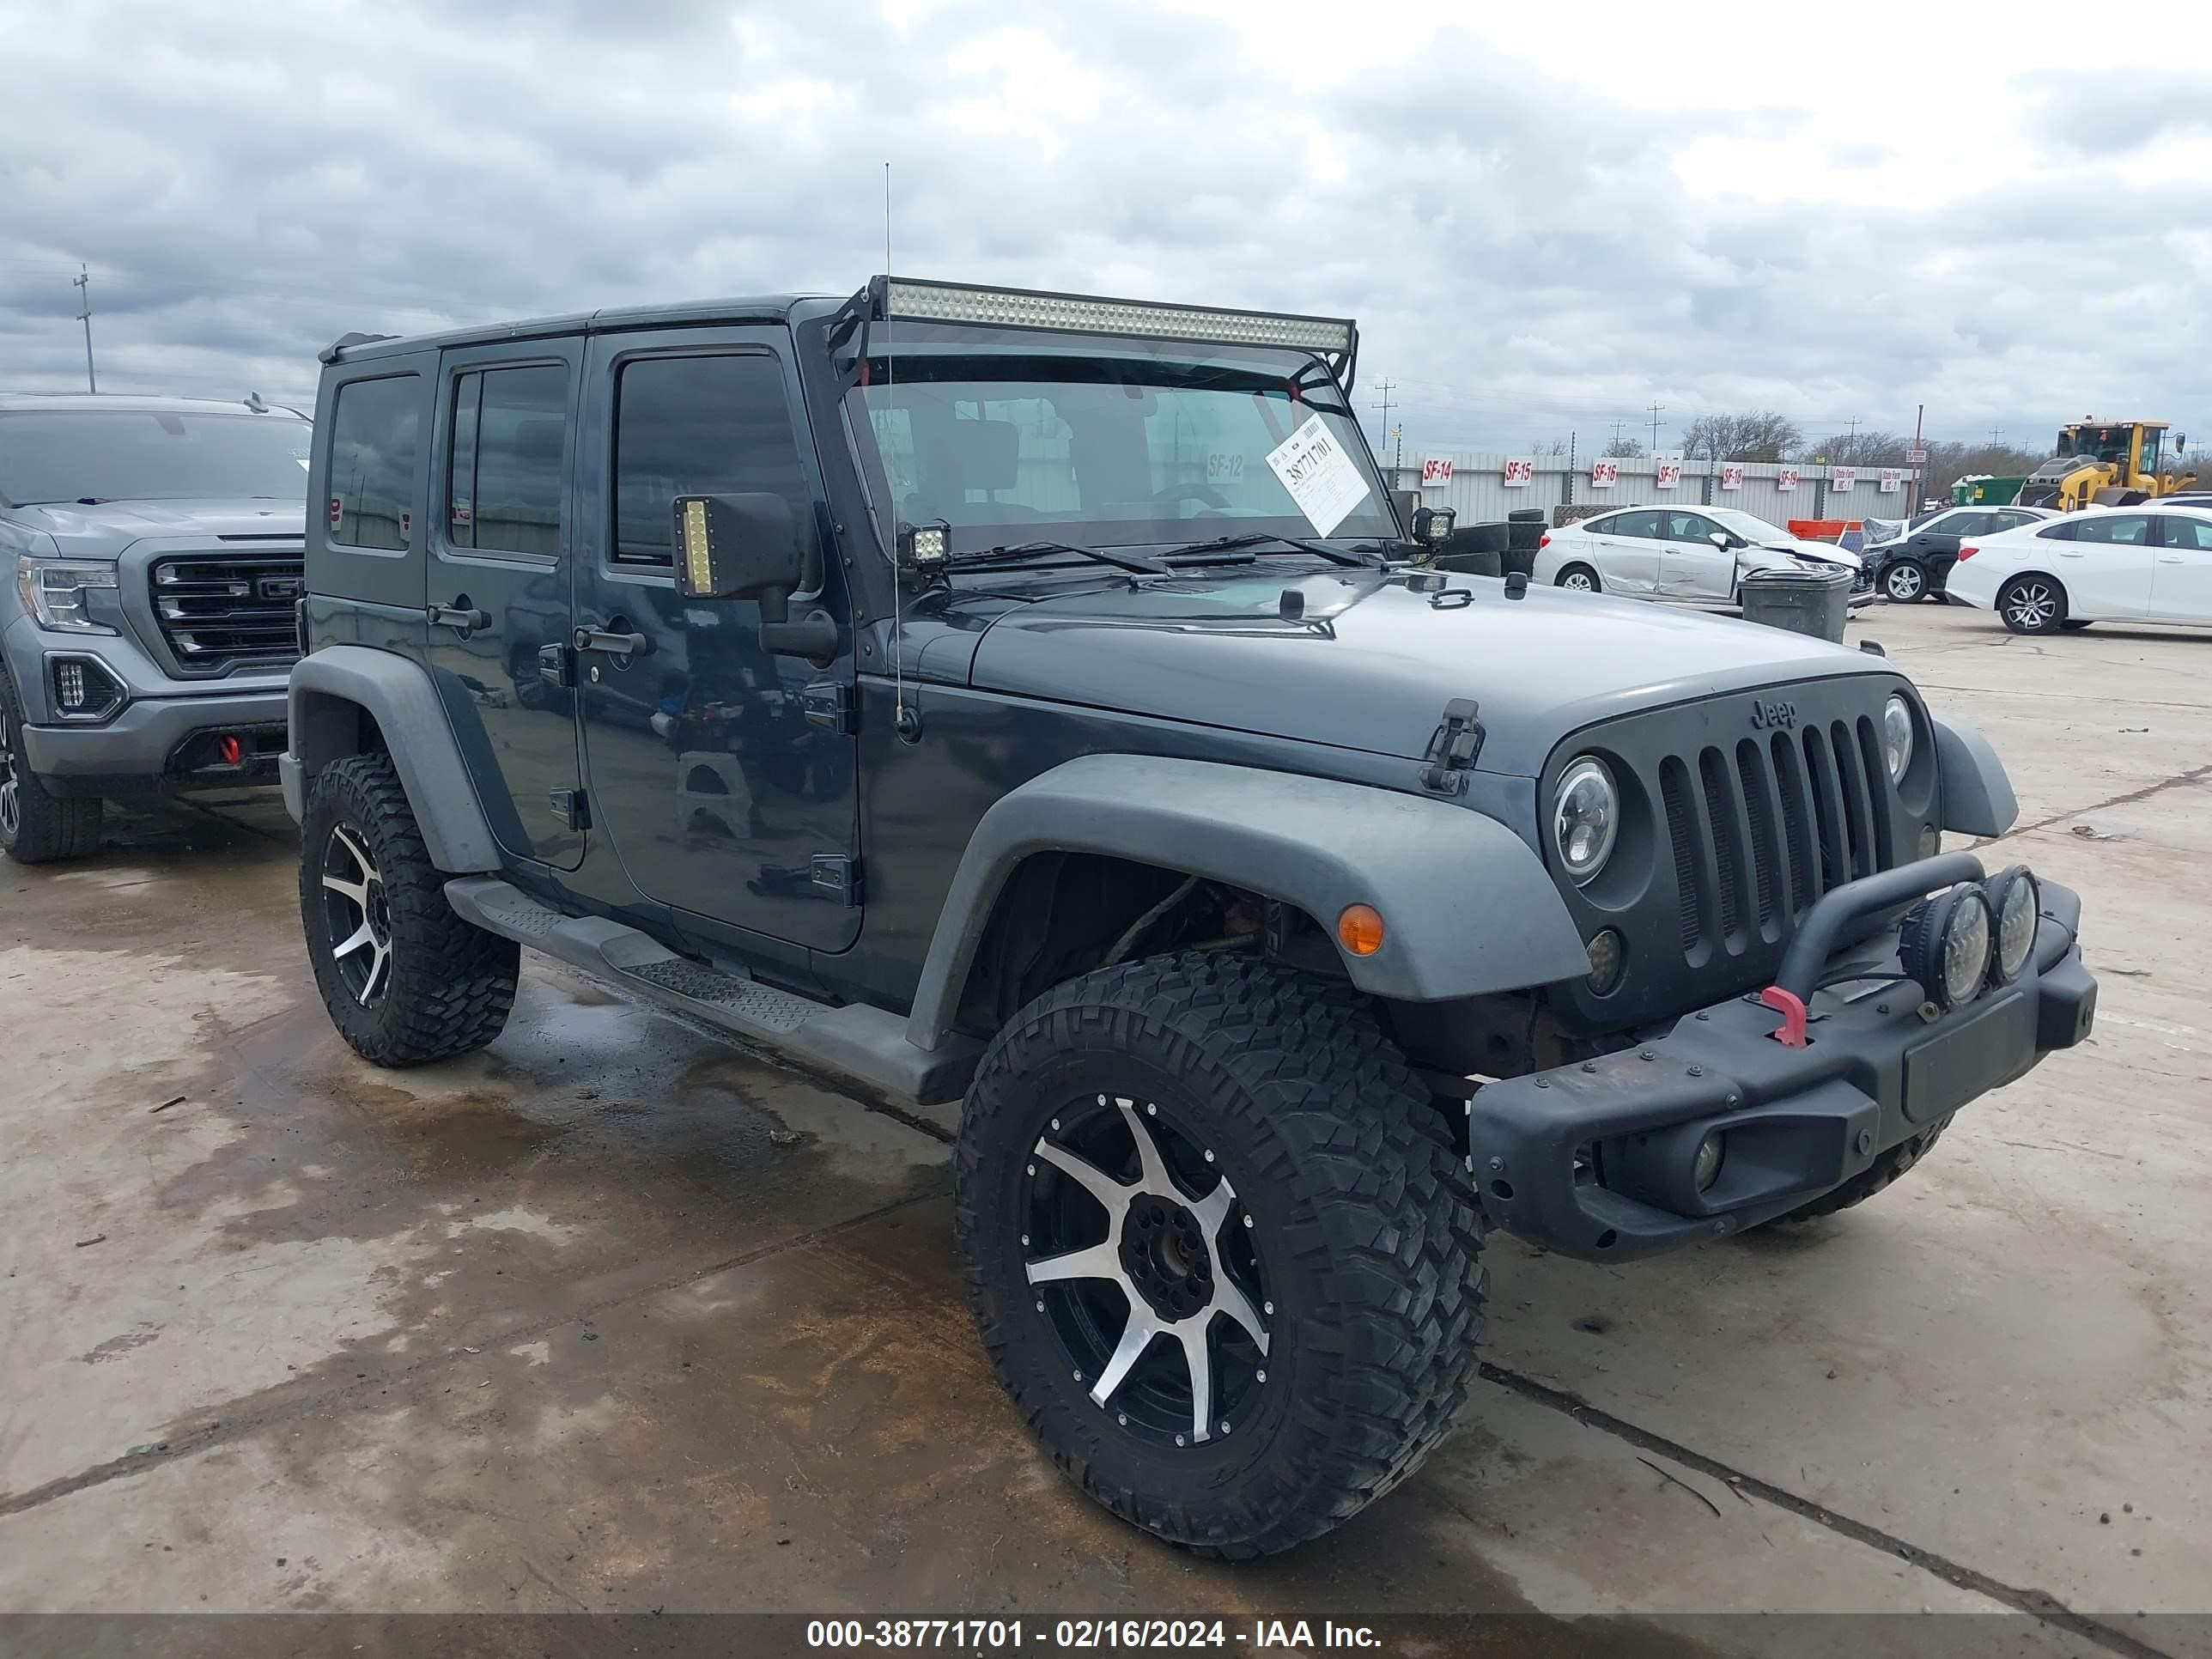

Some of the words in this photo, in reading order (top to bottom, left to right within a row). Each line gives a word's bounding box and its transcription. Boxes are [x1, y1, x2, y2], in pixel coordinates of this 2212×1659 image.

[1208, 453, 1243, 477] SF-12
[1285, 437, 1333, 485] 38771701
[1424, 460, 1452, 480] SF-14
[1506, 461, 1532, 481] SF-15
[1593, 464, 1617, 482] SF-16
[1659, 465, 1680, 483] SF-17
[1723, 468, 1742, 483] SF-18
[1779, 470, 1797, 486] SF-19
[1751, 699, 1797, 729] Jeep
